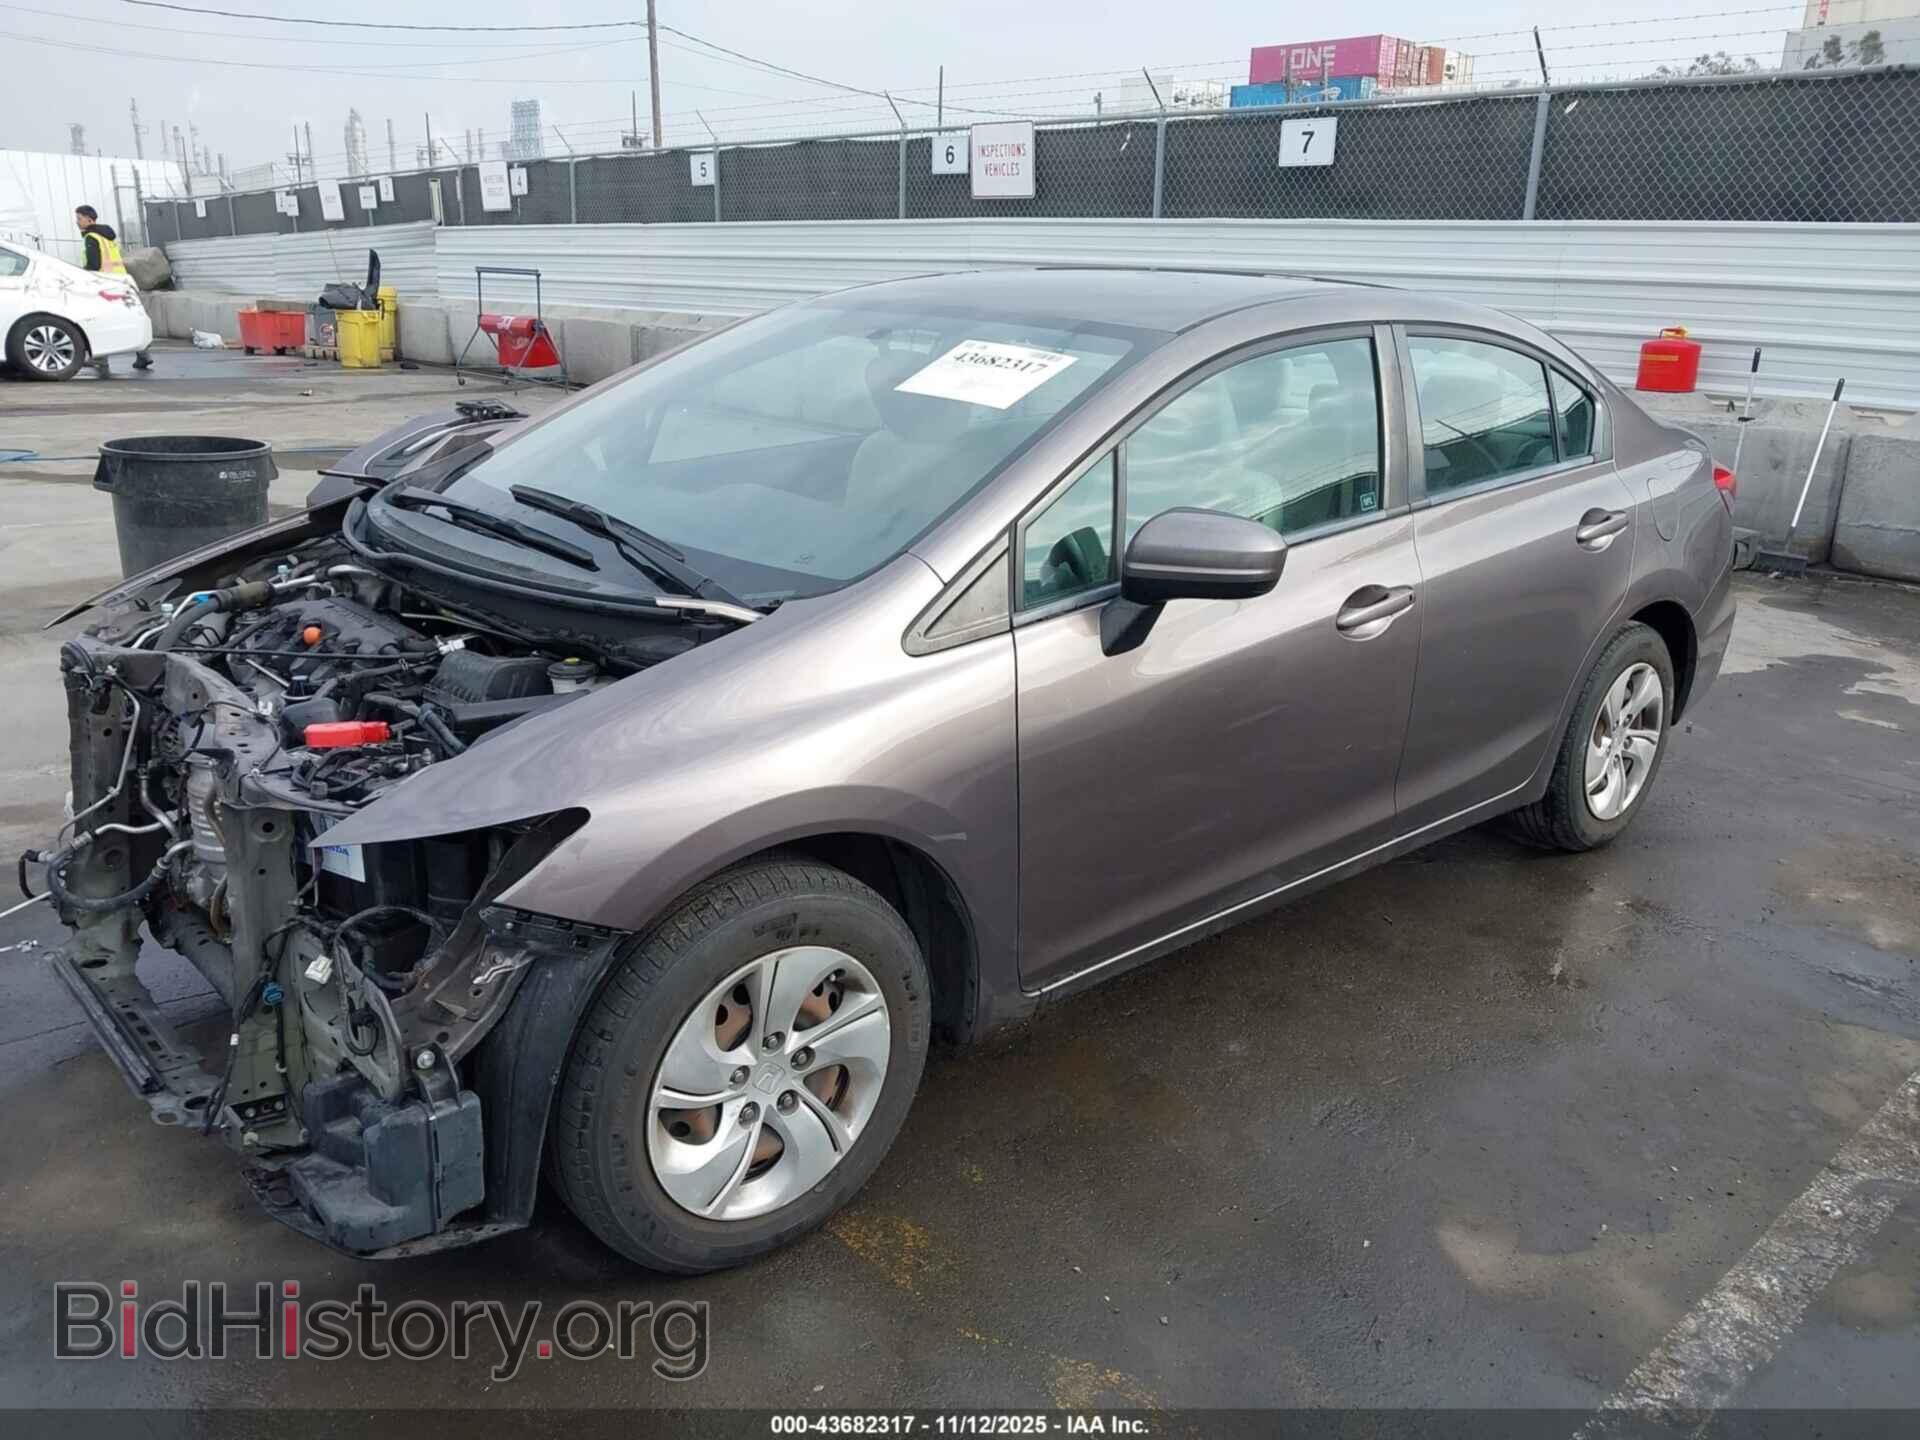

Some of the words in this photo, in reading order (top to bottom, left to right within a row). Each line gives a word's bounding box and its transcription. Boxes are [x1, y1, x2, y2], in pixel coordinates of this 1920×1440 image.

[1290, 45, 1337, 70] ONE
[977, 143, 1027, 158] INSPECTIONS
[1301, 131, 1315, 154] 7
[945, 145, 955, 165] 6
[700, 161, 708, 178] 5
[984, 162, 1020, 177] VEHICLES
[953, 351, 1049, 374] 43682317
